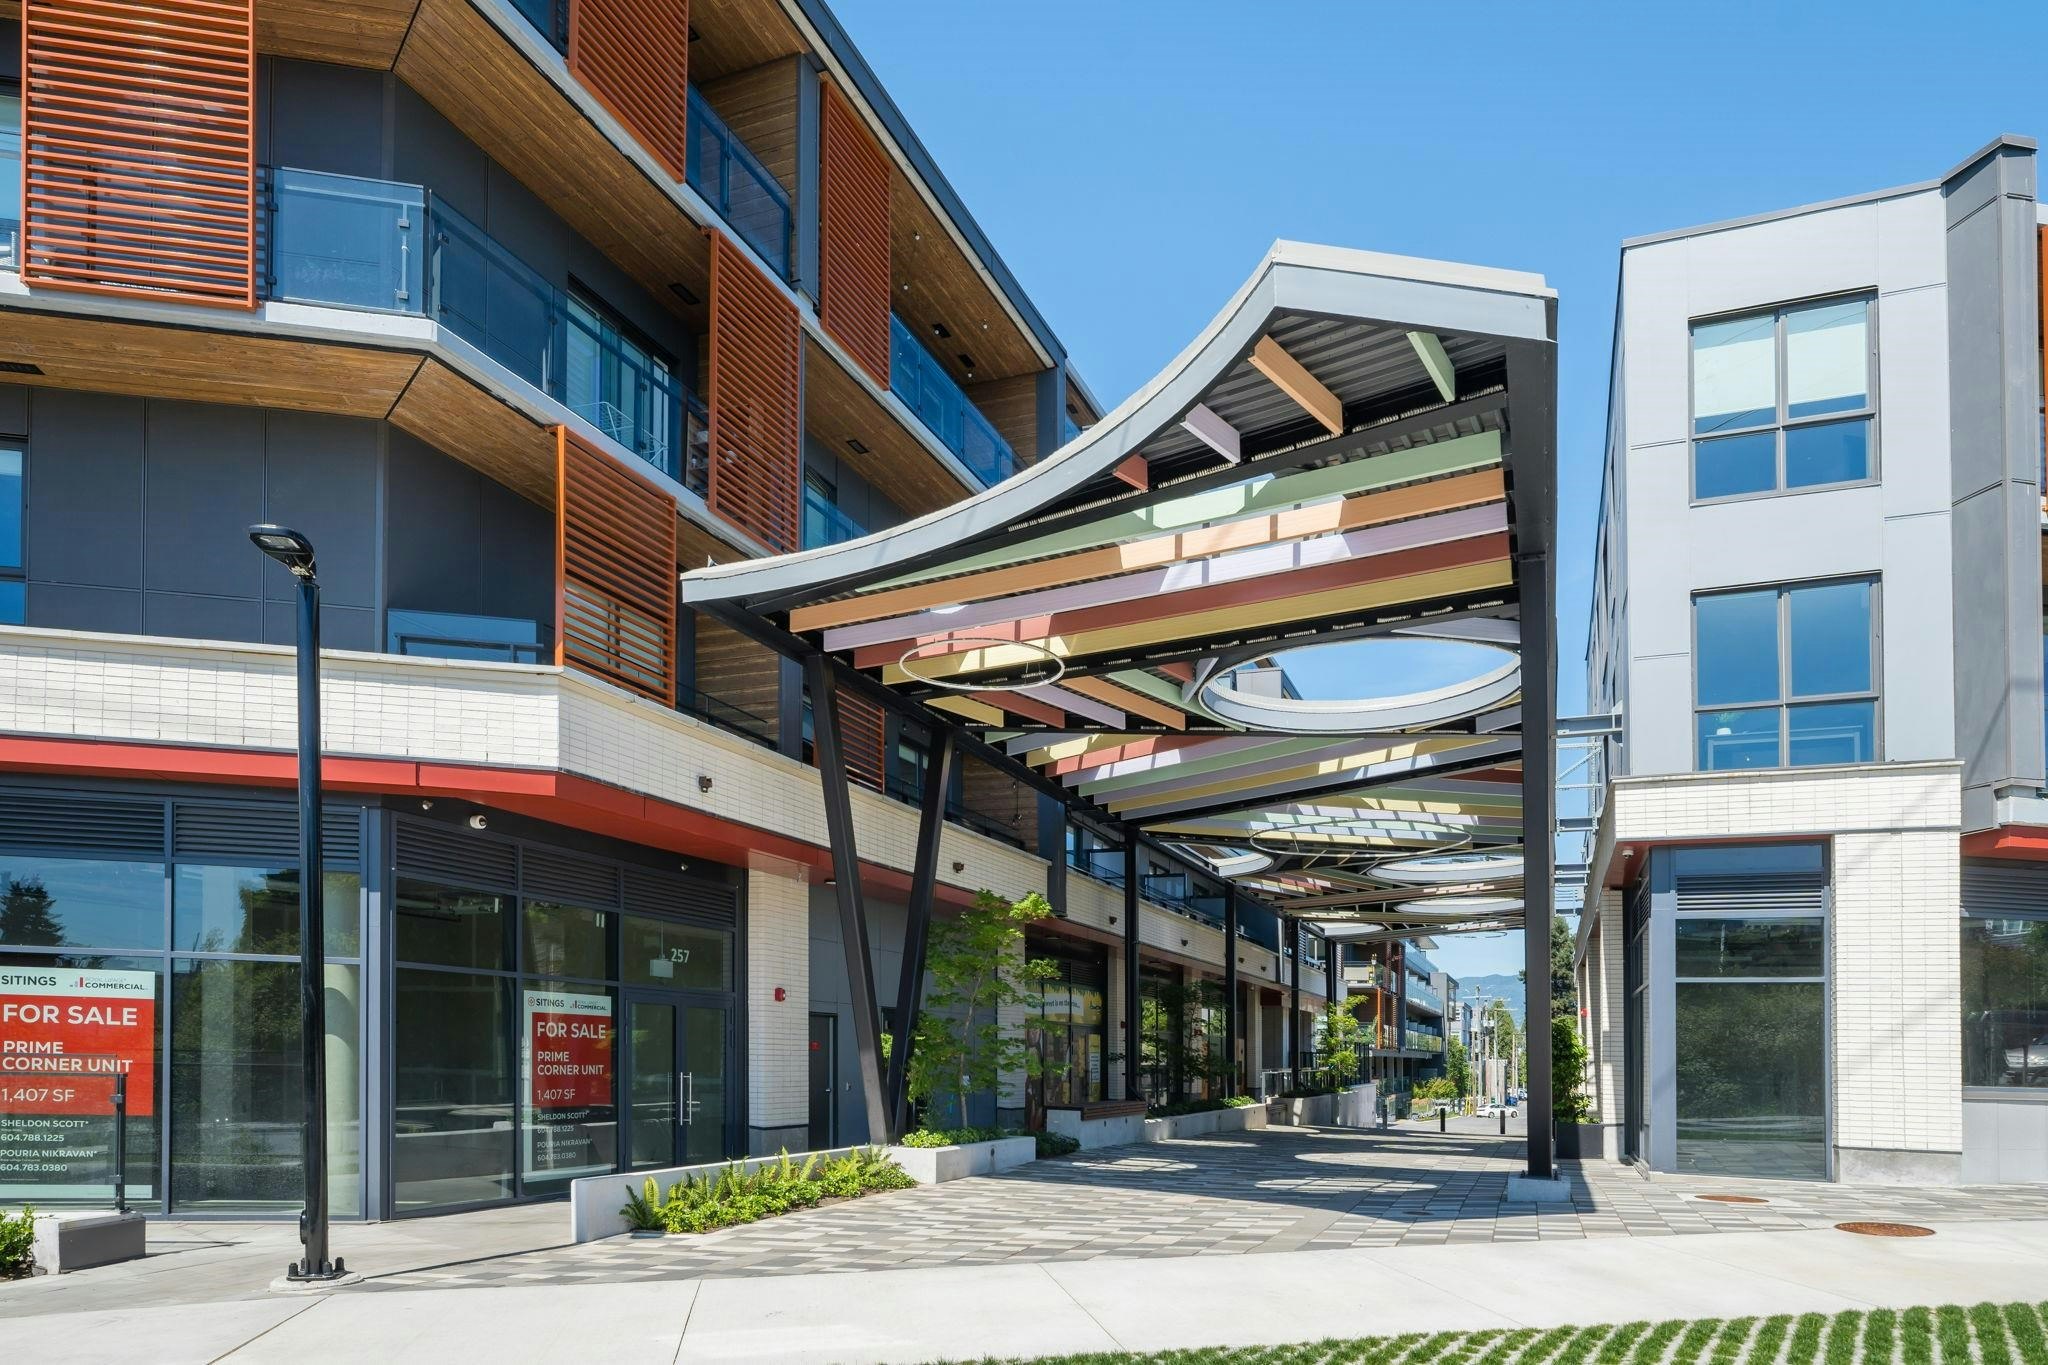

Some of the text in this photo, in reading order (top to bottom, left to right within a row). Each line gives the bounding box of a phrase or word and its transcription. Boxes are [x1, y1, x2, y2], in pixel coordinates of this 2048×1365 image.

[671, 948, 690, 963] 257
[1, 975, 57, 986] SITINGS
[85, 982, 145, 991] COMMERCIAL
[536, 998, 565, 1008] SITINGS
[3, 1003, 138, 1026] FOR SALE
[537, 1021, 607, 1039] FOR SALE
[3, 1040, 64, 1054] PRIME
[537, 1051, 570, 1062] PRIME
[2, 1056, 133, 1073] CORNER UNIT
[537, 1064, 605, 1076] CORNER UNIT
[1, 1088, 75, 1103] 1,407 SF
[537, 1088, 576, 1101] 1,407 SF
[537, 1113, 566, 1121] SHELDON
[1, 1119, 51, 1128] SHELDON
[0, 1133, 65, 1142] 604.788.1225
[0, 1149, 40, 1157] POURIA
[0, 1163, 68, 1172] 604.783.0380
